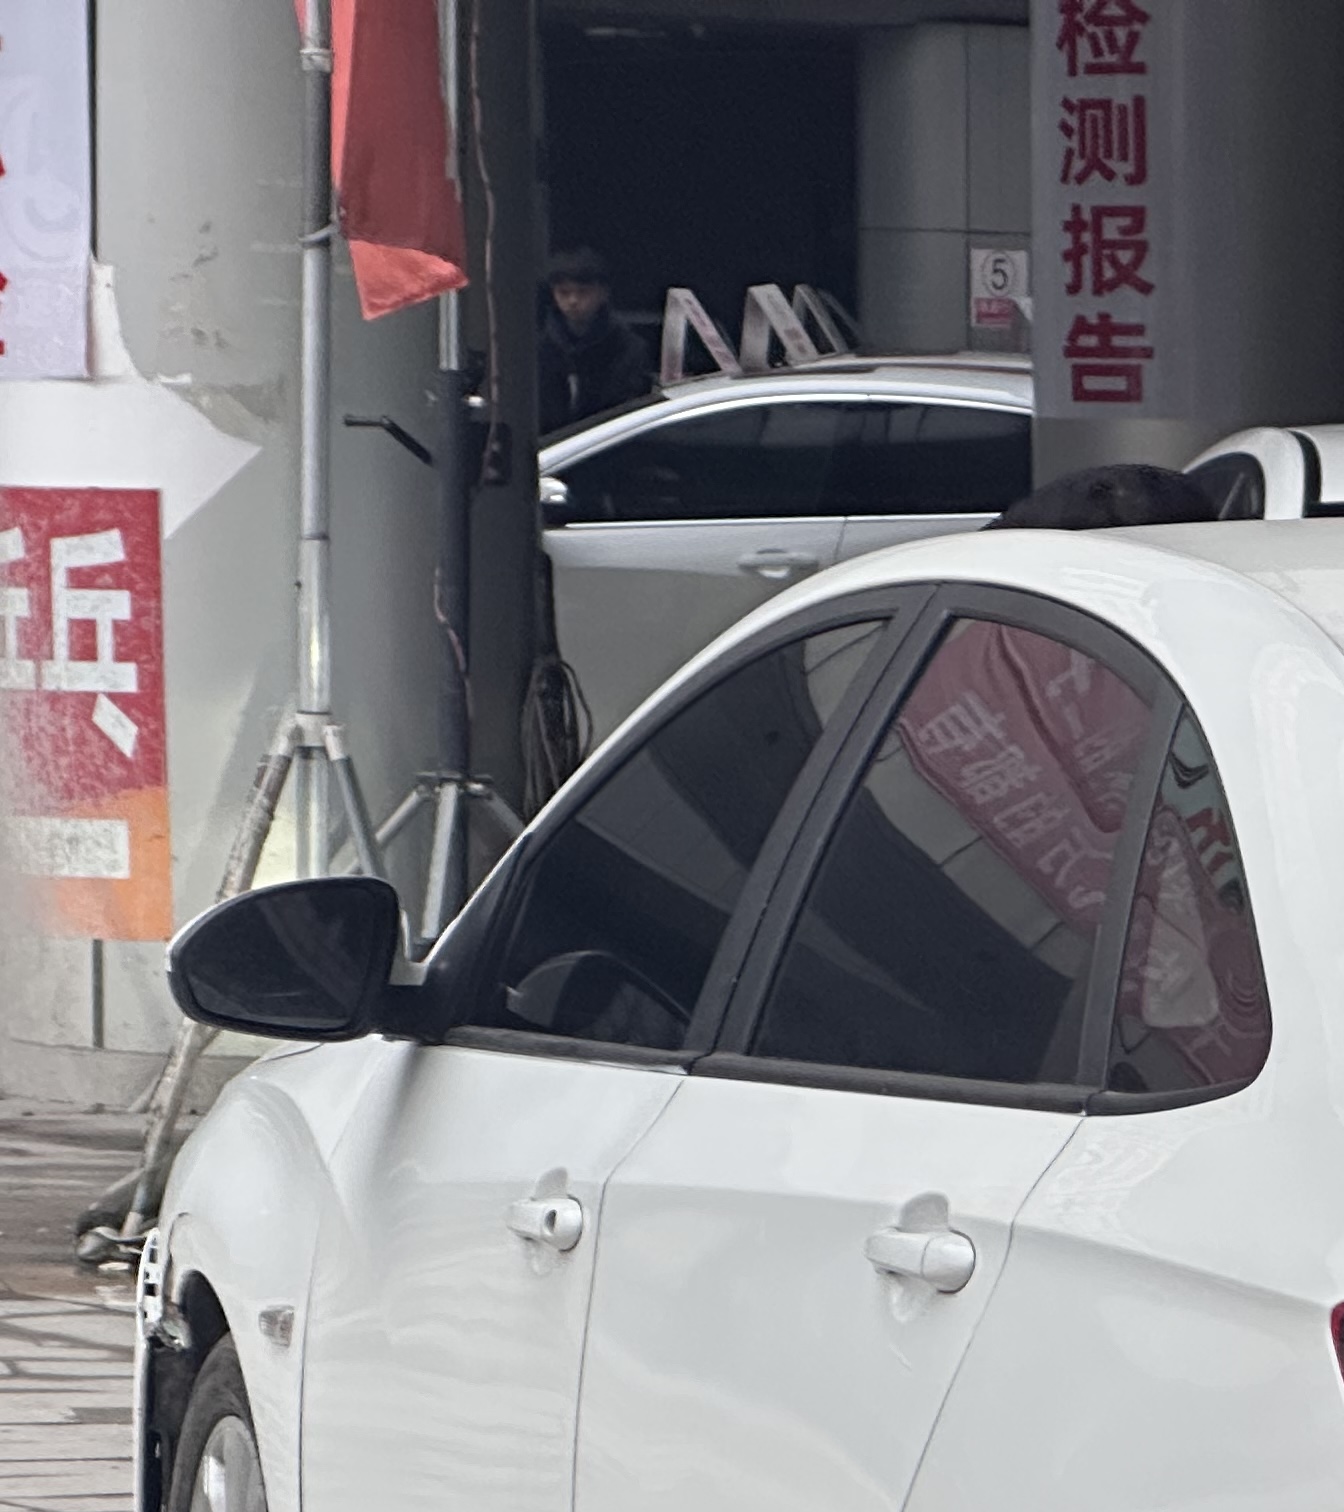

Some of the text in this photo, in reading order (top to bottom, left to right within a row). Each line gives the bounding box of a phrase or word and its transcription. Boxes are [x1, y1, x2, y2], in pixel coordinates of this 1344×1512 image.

[991, 258, 1009, 290] 5
[1056, 0, 1156, 403] 检测报告
